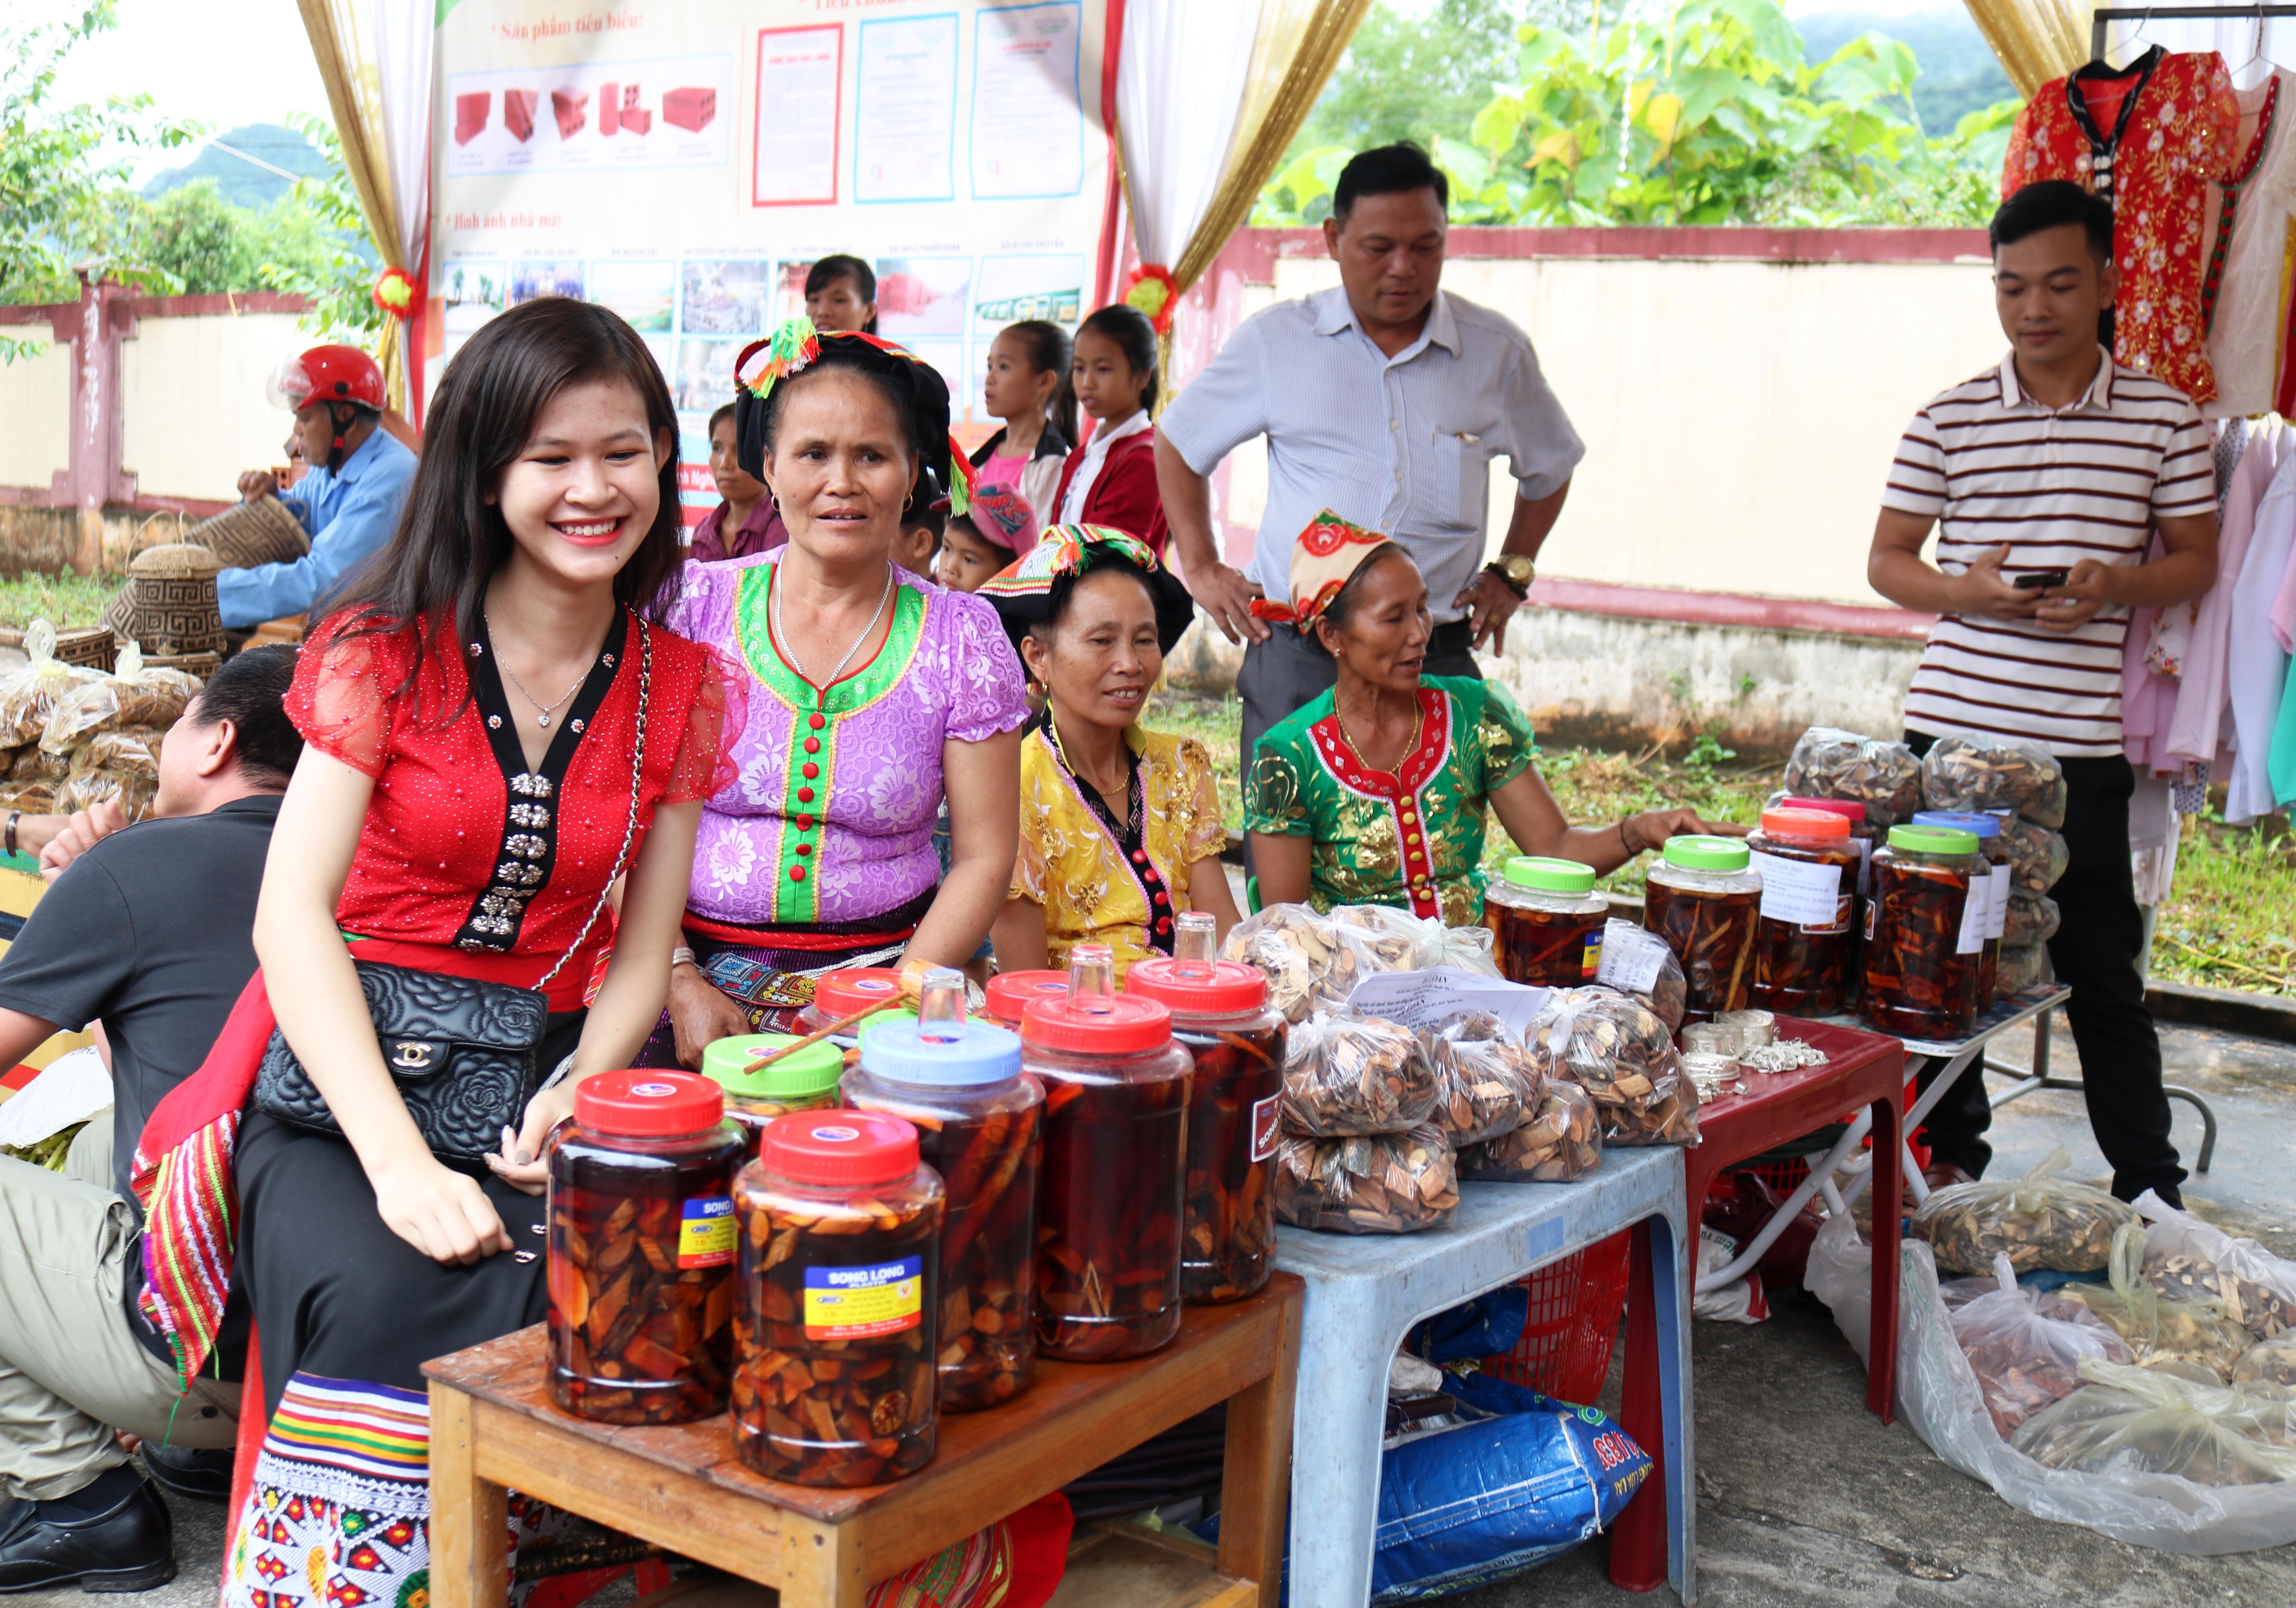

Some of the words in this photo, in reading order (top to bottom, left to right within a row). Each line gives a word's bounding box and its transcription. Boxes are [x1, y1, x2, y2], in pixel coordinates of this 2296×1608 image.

[1259, 1118, 1279, 1149] SONG
[703, 1200, 730, 1214] SONG
[828, 1271, 869, 1285] SONG
[870, 1264, 905, 1281] LONG
[848, 1279, 888, 1289] PLASTIC
